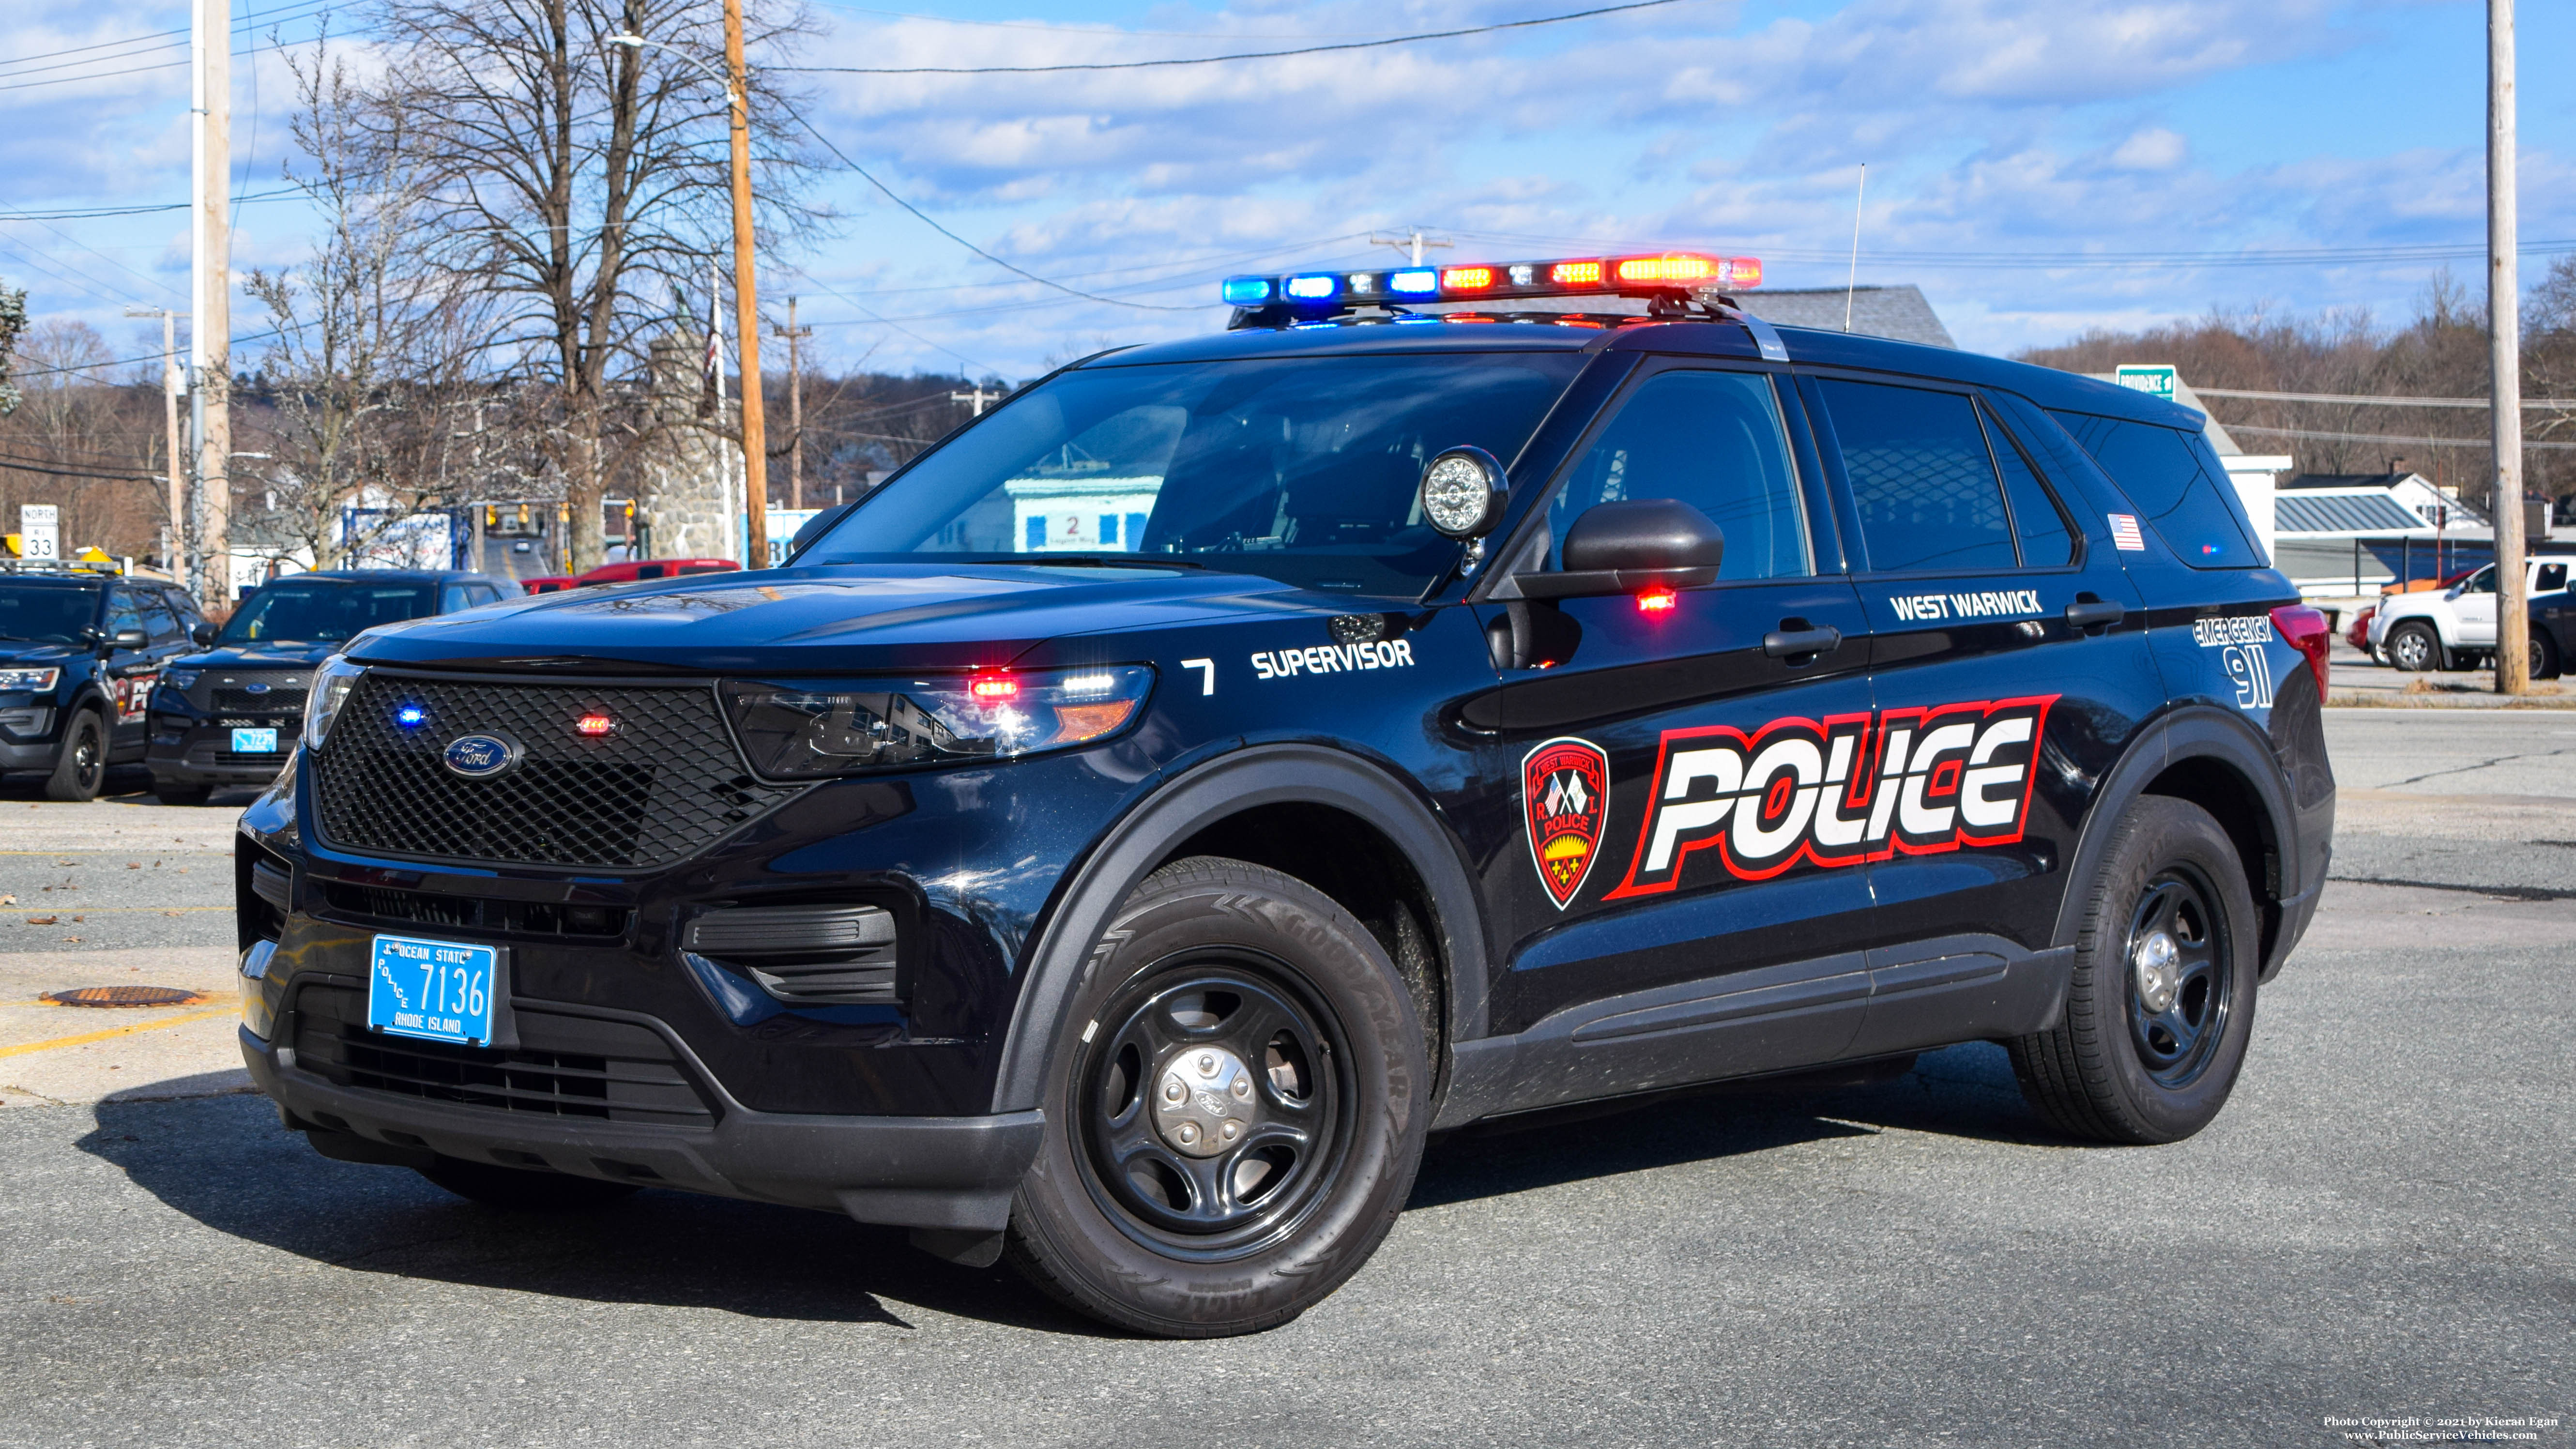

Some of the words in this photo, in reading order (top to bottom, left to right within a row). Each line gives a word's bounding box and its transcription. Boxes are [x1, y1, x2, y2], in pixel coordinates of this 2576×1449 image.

[25, 509, 56, 519] NORTH
[1067, 516, 1079, 534] 2
[30, 539, 51, 555] 33
[1890, 595, 1949, 621] WEST
[1950, 590, 2043, 617] WARWICK
[2193, 616, 2272, 647] EMERGENCY
[1251, 639, 1415, 679] SUPERVISOR
[1181, 658, 1214, 696] 7
[2223, 644, 2273, 709] 911
[251, 733, 273, 745] 7239
[457, 742, 494, 765] Ford
[1540, 761, 1558, 774] WEST
[1560, 756, 1590, 770] WARWICK
[1645, 717, 2032, 871] POLICE
[1536, 802, 1548, 820] R.
[1544, 813, 1590, 836] POLICE
[399, 946, 429, 961] OCEAN
[378, 959, 409, 1008] POLICE
[420, 964, 483, 1017] 7136
[395, 1012, 425, 1029] RHODE
[428, 1016, 460, 1034] ISLAND
